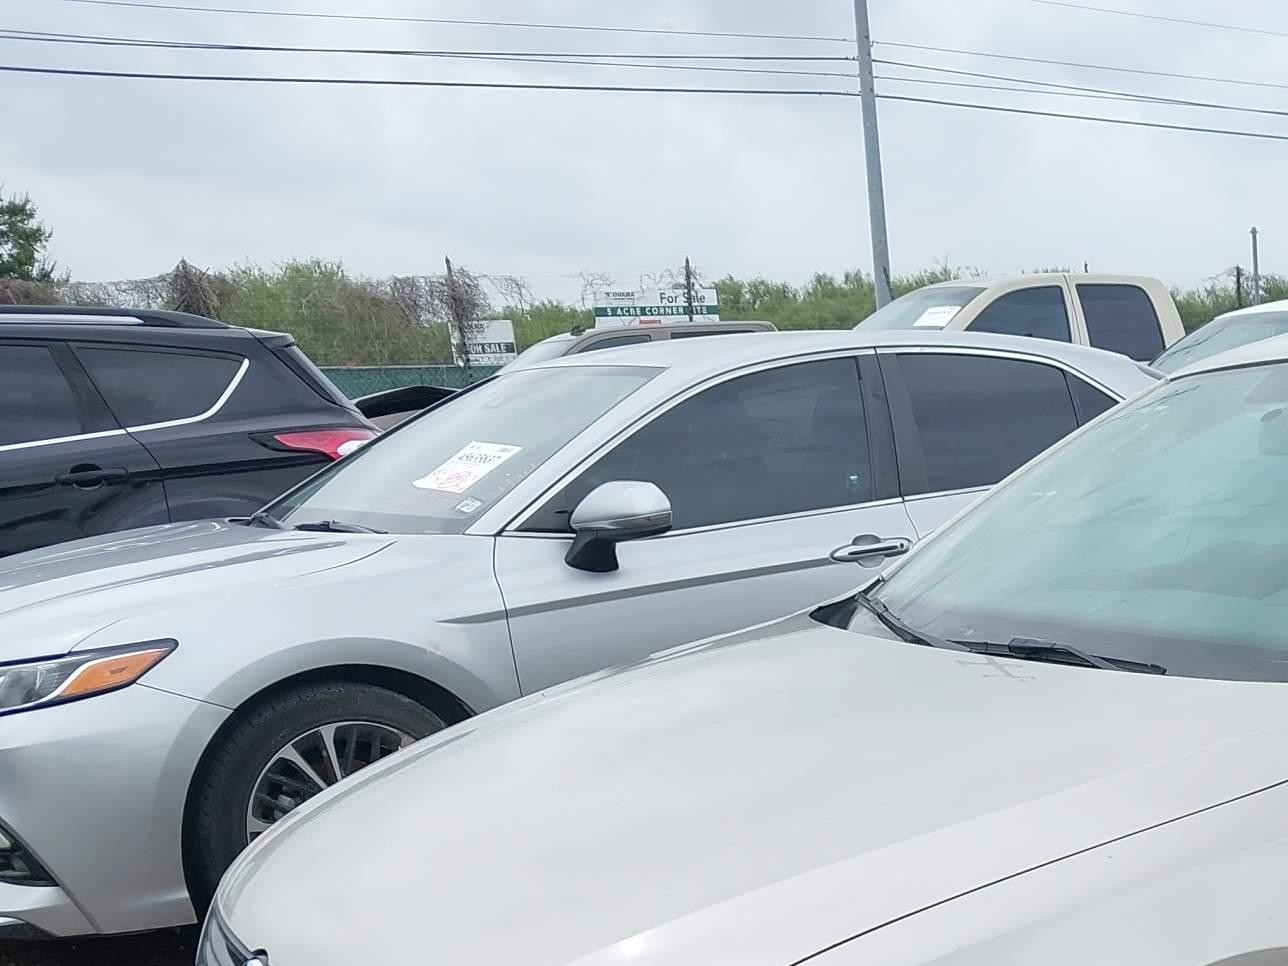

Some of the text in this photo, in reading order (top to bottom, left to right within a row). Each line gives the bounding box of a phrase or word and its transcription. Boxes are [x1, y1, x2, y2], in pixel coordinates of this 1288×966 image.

[660, 292, 678, 304] For
[607, 307, 612, 316] 5
[617, 307, 641, 316] ACRE
[645, 306, 684, 316] CORNER
[484, 343, 508, 353] SALE
